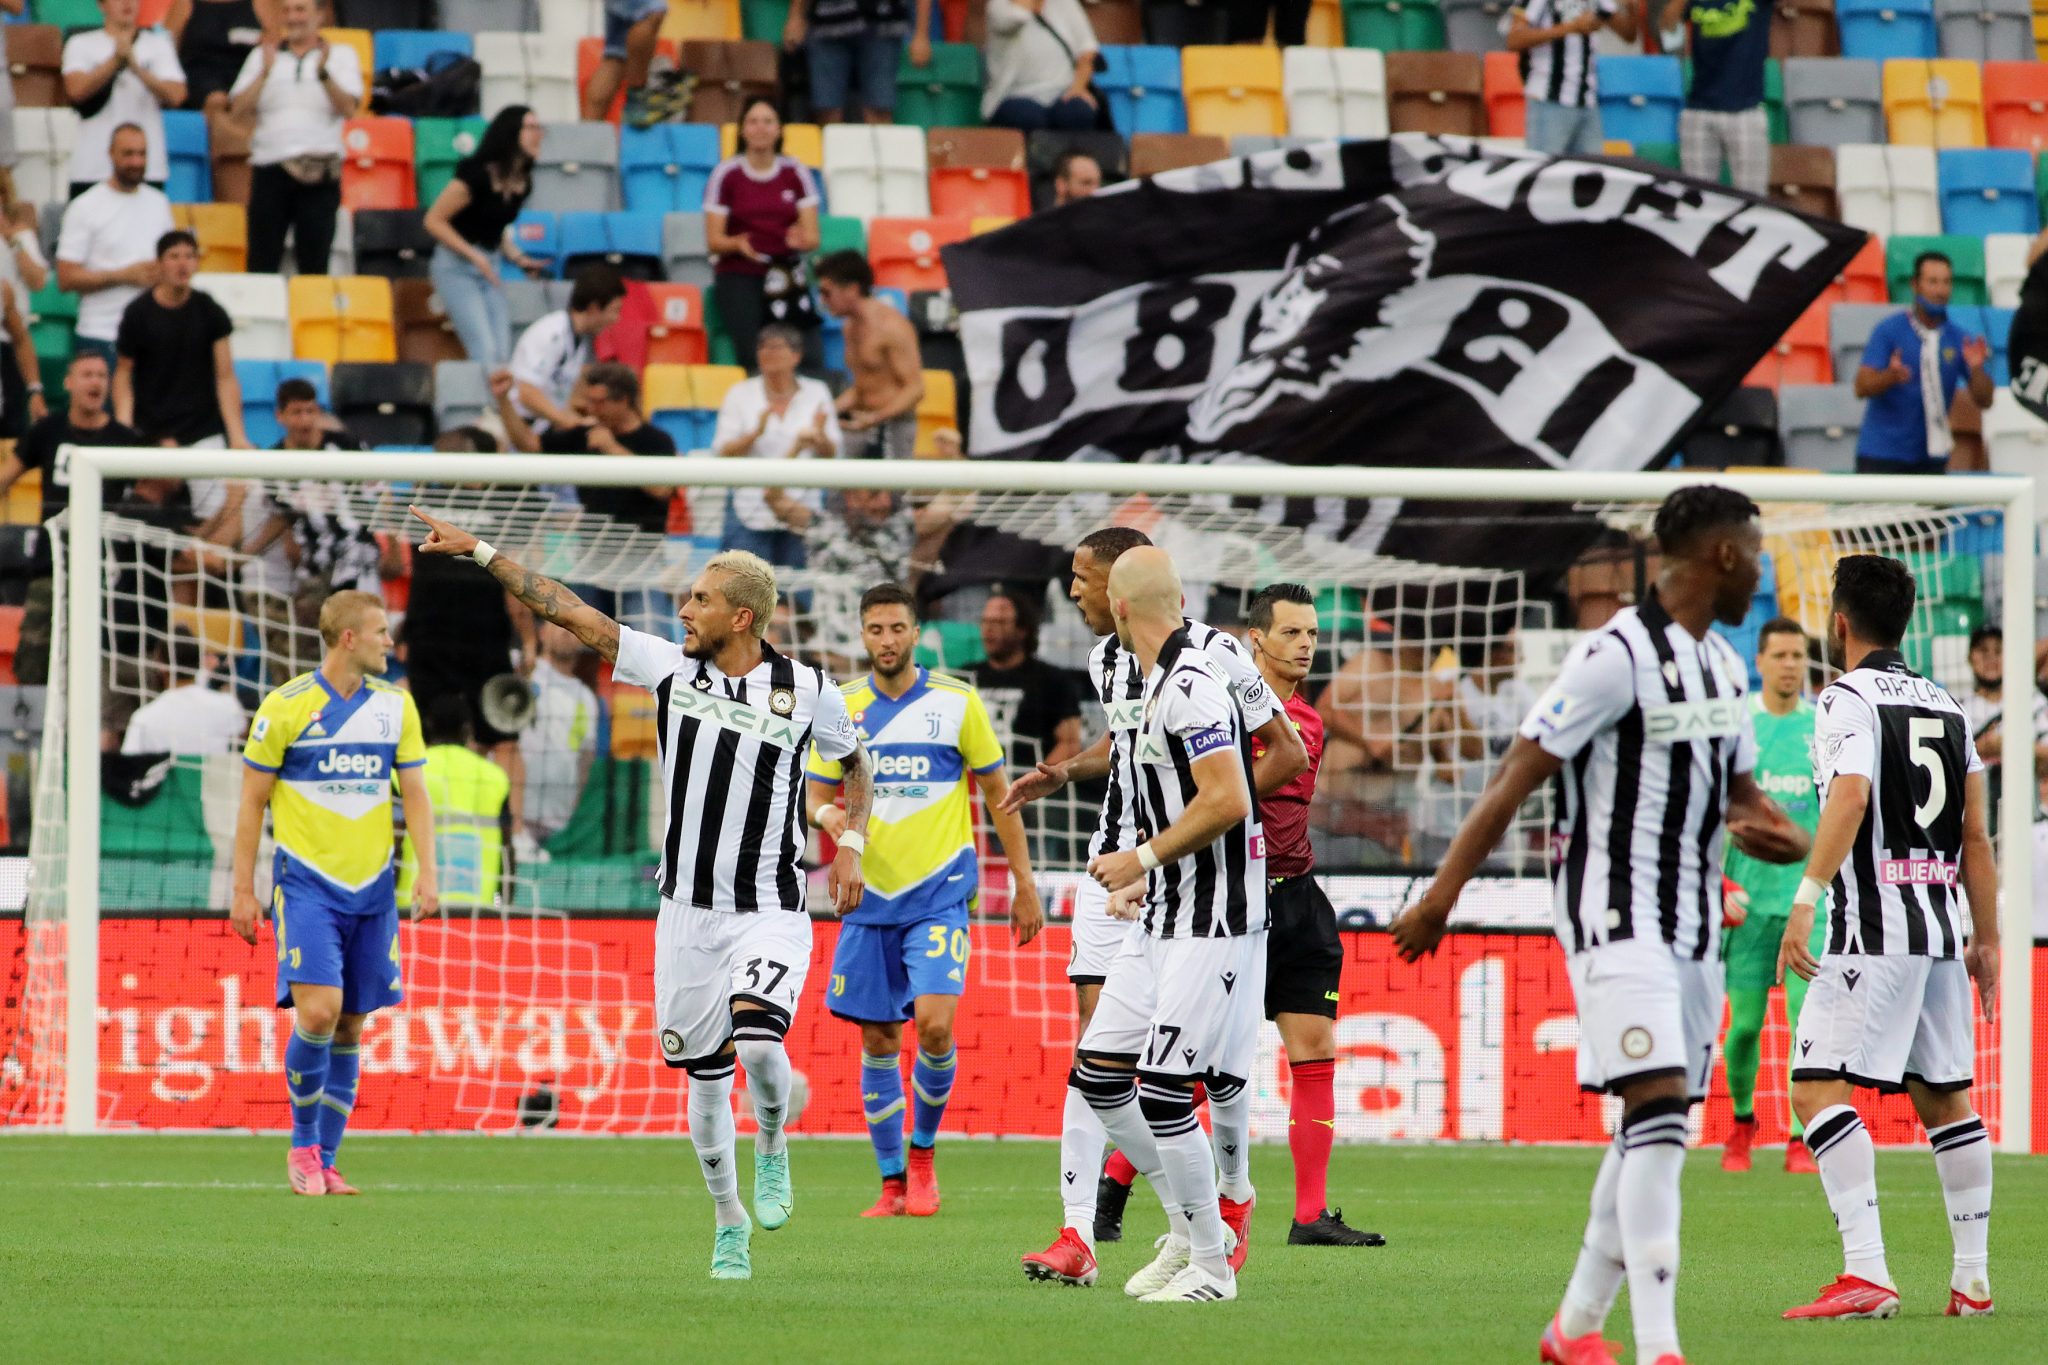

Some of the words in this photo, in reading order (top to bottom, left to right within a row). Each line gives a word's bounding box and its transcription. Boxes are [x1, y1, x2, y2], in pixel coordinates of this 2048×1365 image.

[672, 689, 793, 746] DACIA
[318, 748, 383, 778] Jeep
[871, 749, 931, 780] Jeep
[1908, 717, 1947, 829] 5
[925, 925, 966, 963] 30
[743, 957, 790, 994] 37
